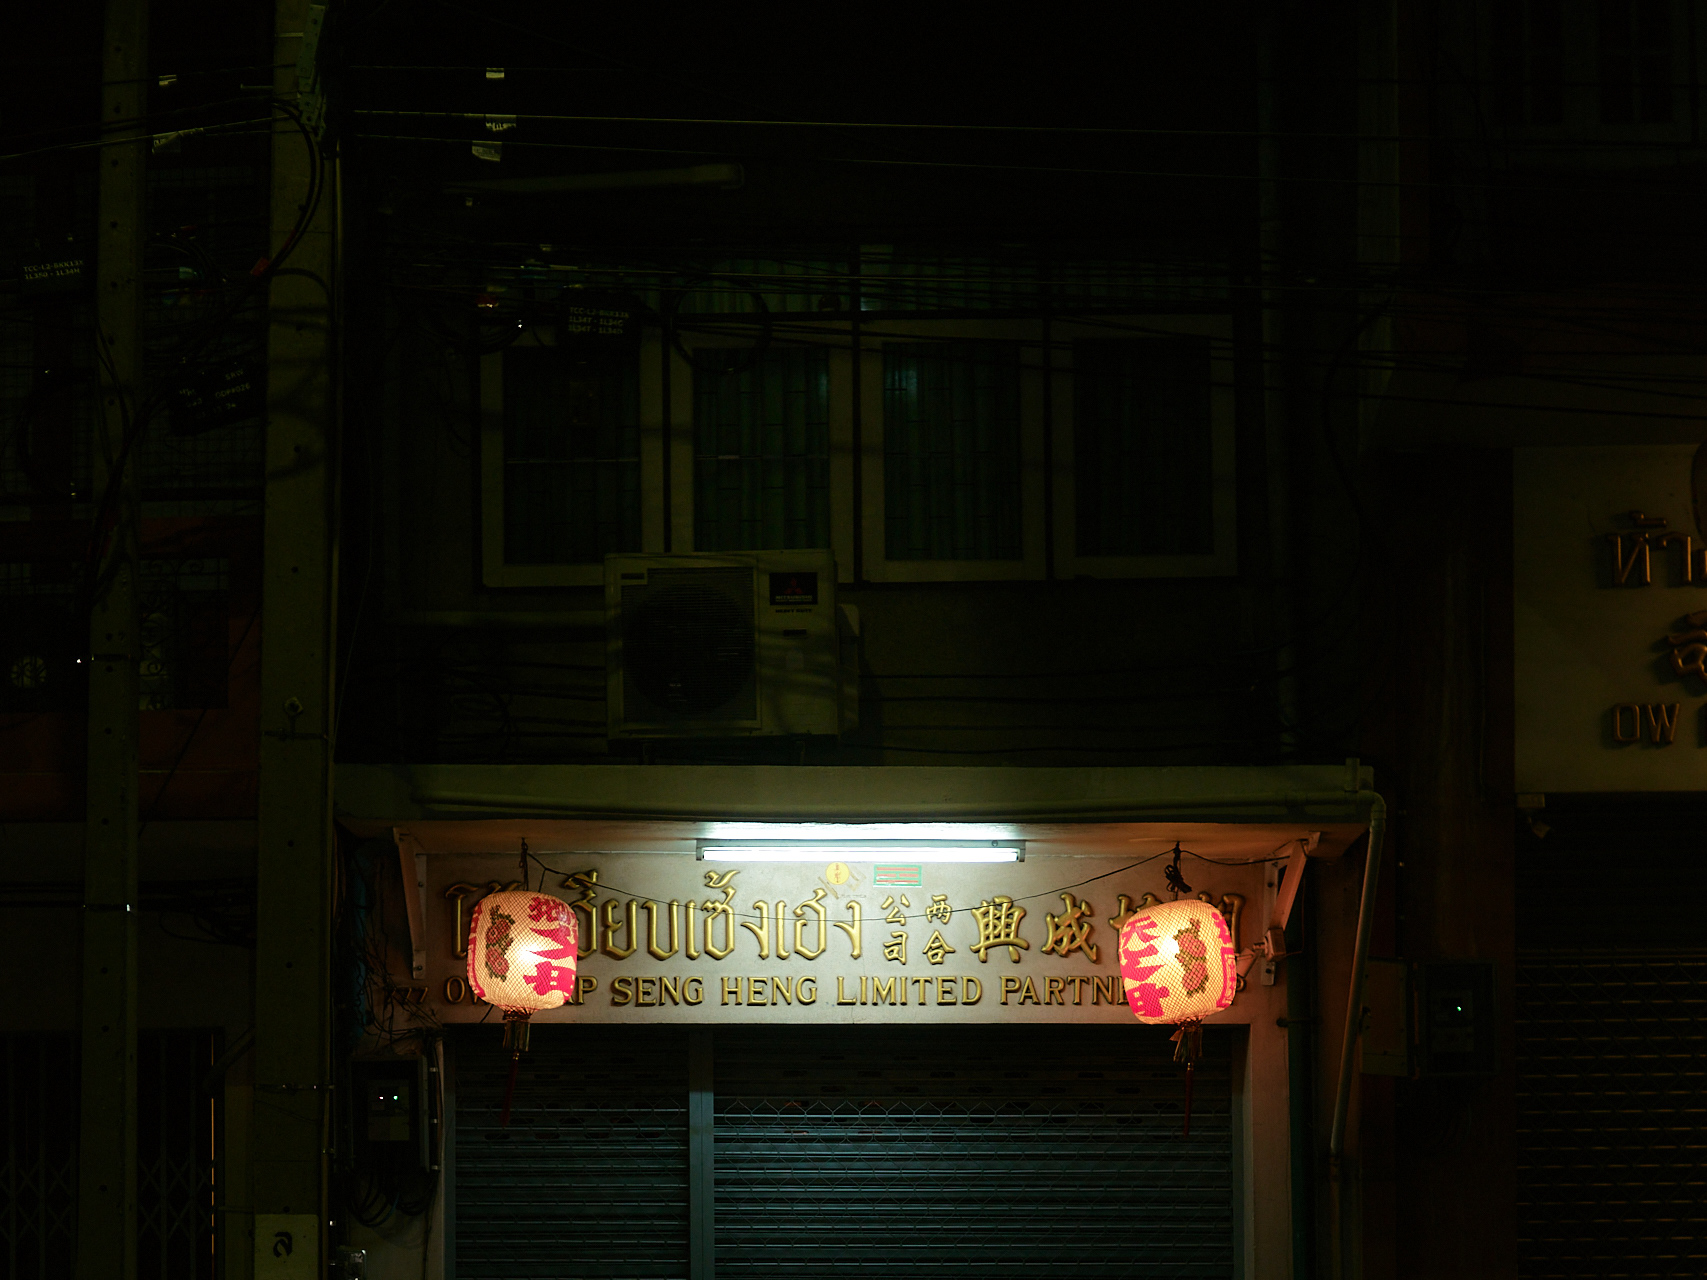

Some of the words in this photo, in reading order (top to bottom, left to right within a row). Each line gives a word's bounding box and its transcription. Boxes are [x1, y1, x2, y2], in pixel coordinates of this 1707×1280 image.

[1614, 703, 1680, 744] OW
[611, 976, 704, 1006] SENG
[720, 976, 818, 1006] HENG
[836, 975, 983, 1006] LIMITED
